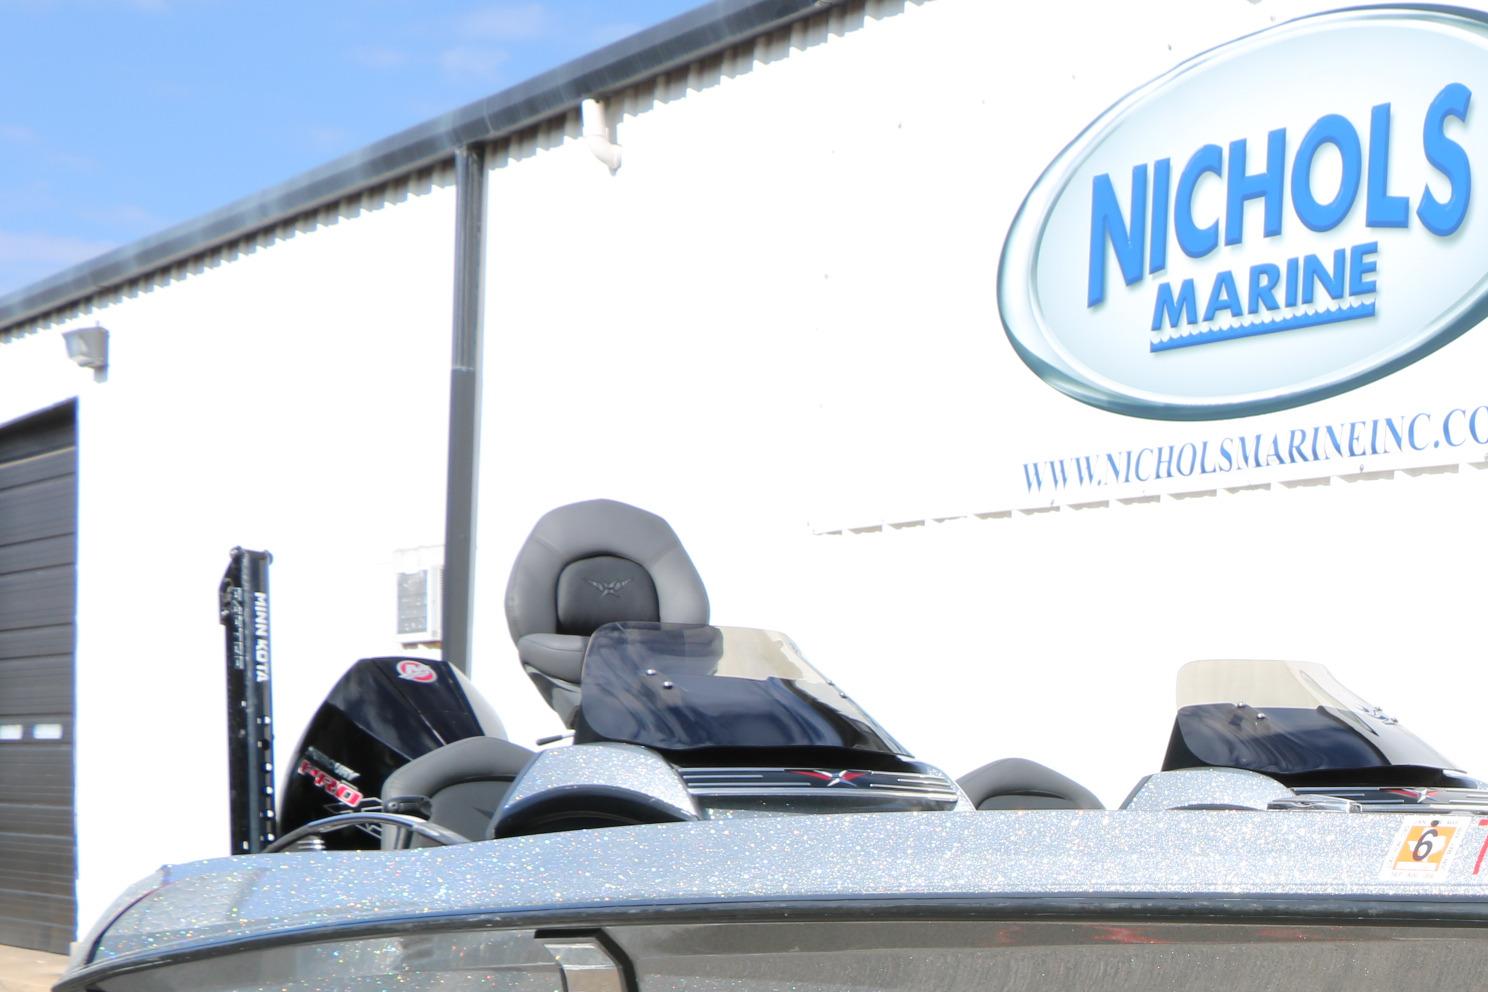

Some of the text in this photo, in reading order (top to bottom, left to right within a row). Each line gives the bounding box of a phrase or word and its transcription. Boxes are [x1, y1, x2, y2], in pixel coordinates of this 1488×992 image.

[1087, 82, 1473, 309] NICHOLS
[1150, 241, 1379, 331] MARINE
[253, 591, 270, 682] MINN KOTA
[1412, 828, 1439, 862] 6
